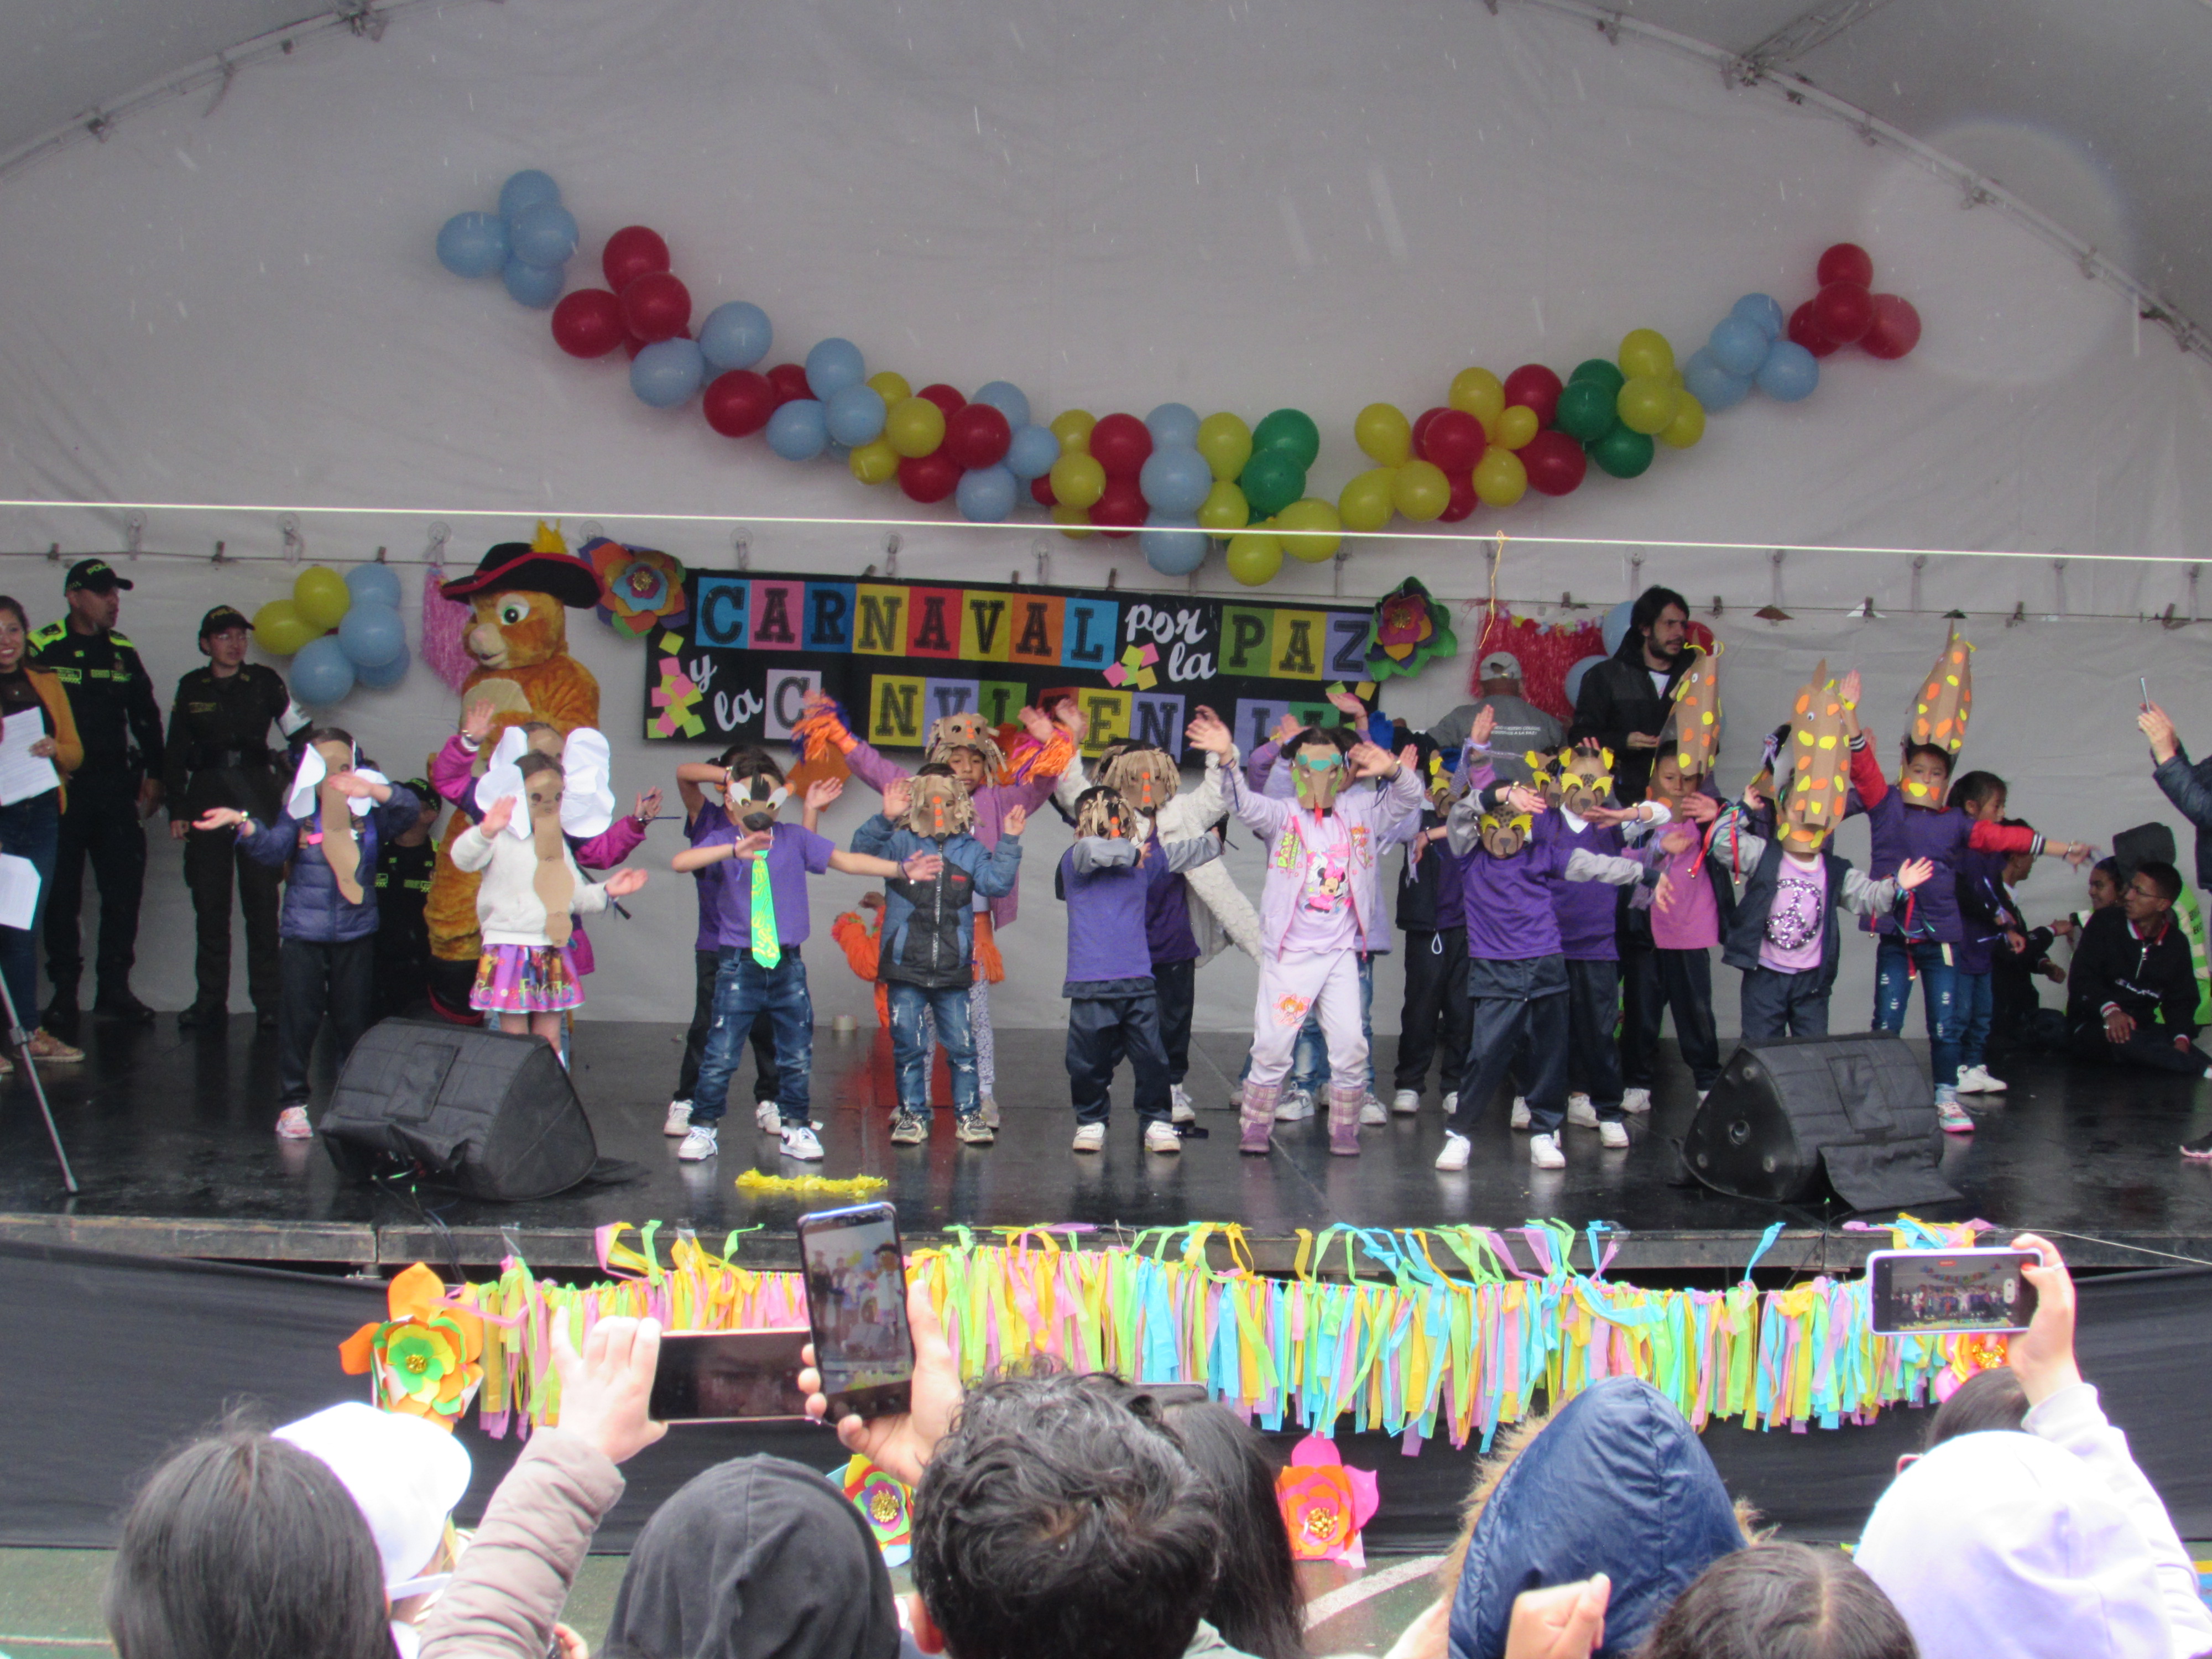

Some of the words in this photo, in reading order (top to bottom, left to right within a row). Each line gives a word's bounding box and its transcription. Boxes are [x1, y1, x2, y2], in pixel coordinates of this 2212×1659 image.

[701, 585, 1104, 663] CARNAVAL
[1124, 603, 1207, 645] por
[1167, 641, 1217, 682] la
[1229, 614, 1370, 674] PAZ
[689, 654, 718, 693] y
[713, 688, 763, 732] la
